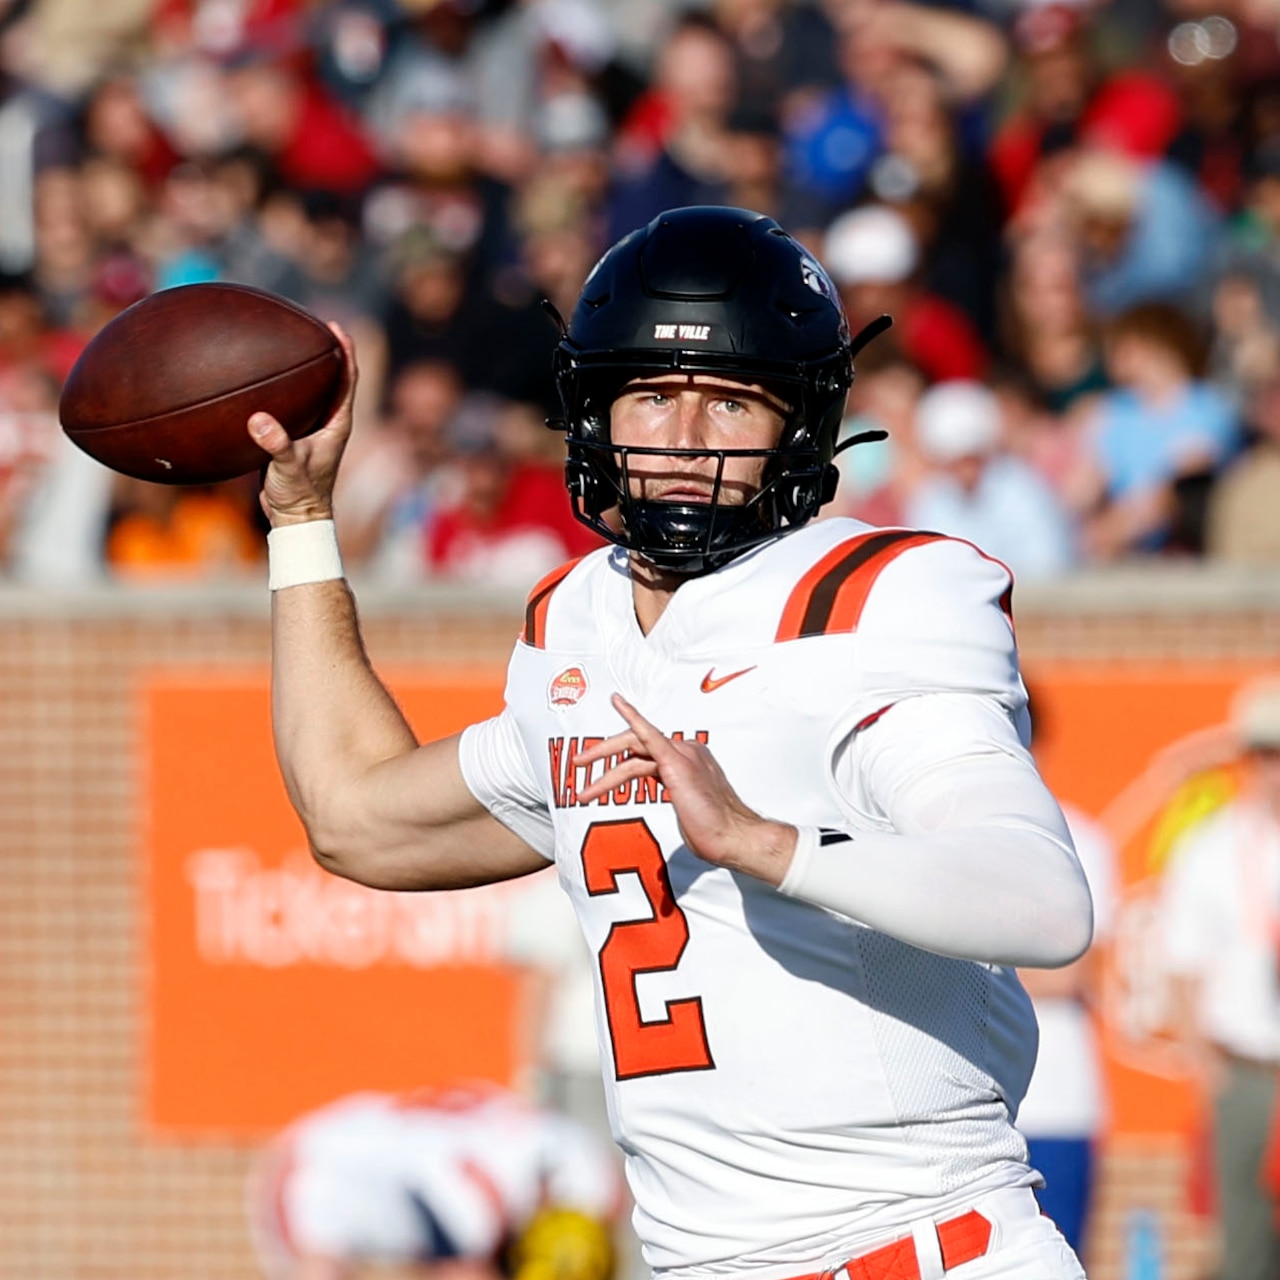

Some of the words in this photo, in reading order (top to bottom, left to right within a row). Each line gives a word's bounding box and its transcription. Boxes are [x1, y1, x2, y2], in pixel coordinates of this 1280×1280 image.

[654, 324, 678, 339] THE
[678, 324, 711, 340] VILLE
[581, 817, 716, 1081] 2
